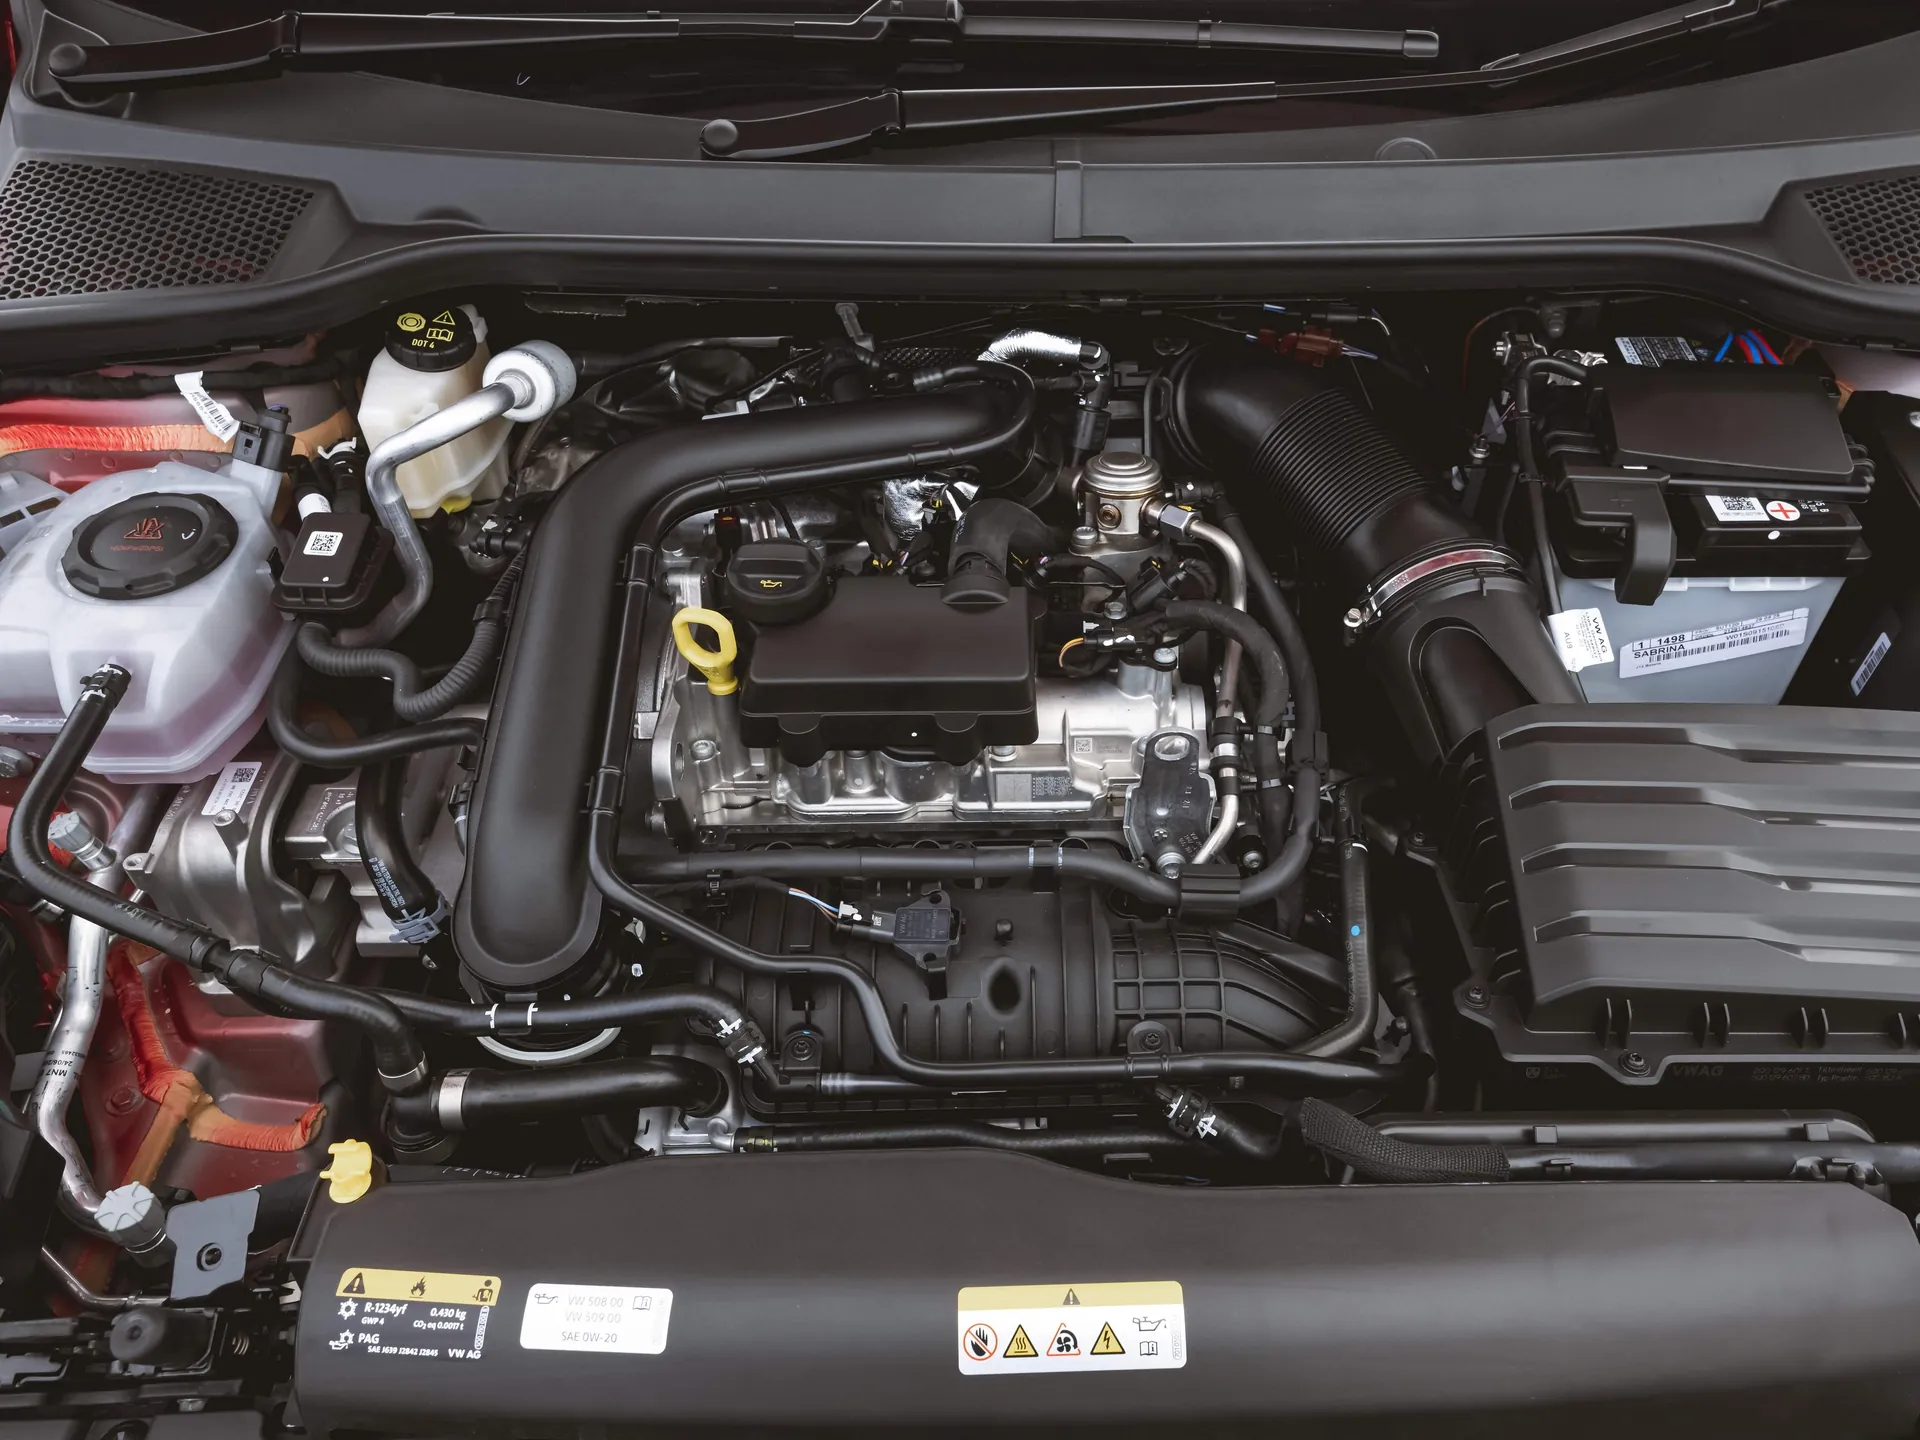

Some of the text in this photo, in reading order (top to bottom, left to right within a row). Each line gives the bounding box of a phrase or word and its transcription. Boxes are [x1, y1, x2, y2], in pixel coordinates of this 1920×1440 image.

[412, 339, 428, 348] DOT
[1591, 617, 1608, 653] VW AG
[1656, 634, 1686, 645] 1498
[1634, 644, 1686, 659] SABRINA
[568, 1294, 624, 1308] VW 508 00
[364, 1302, 408, 1317] R-1234yf
[430, 1307, 467, 1321] 0.430 kg
[566, 1310, 622, 1324] VW 509 00
[427, 1322, 436, 1331] eq
[437, 1321, 459, 1330] 0.0017
[358, 1333, 380, 1344] PAG
[561, 1331, 618, 1344] SAE 0W-20
[381, 1346, 398, 1354] J639
[399, 1347, 418, 1355] J2842
[419, 1348, 438, 1356] J2845
[448, 1348, 481, 1360] VW AG
